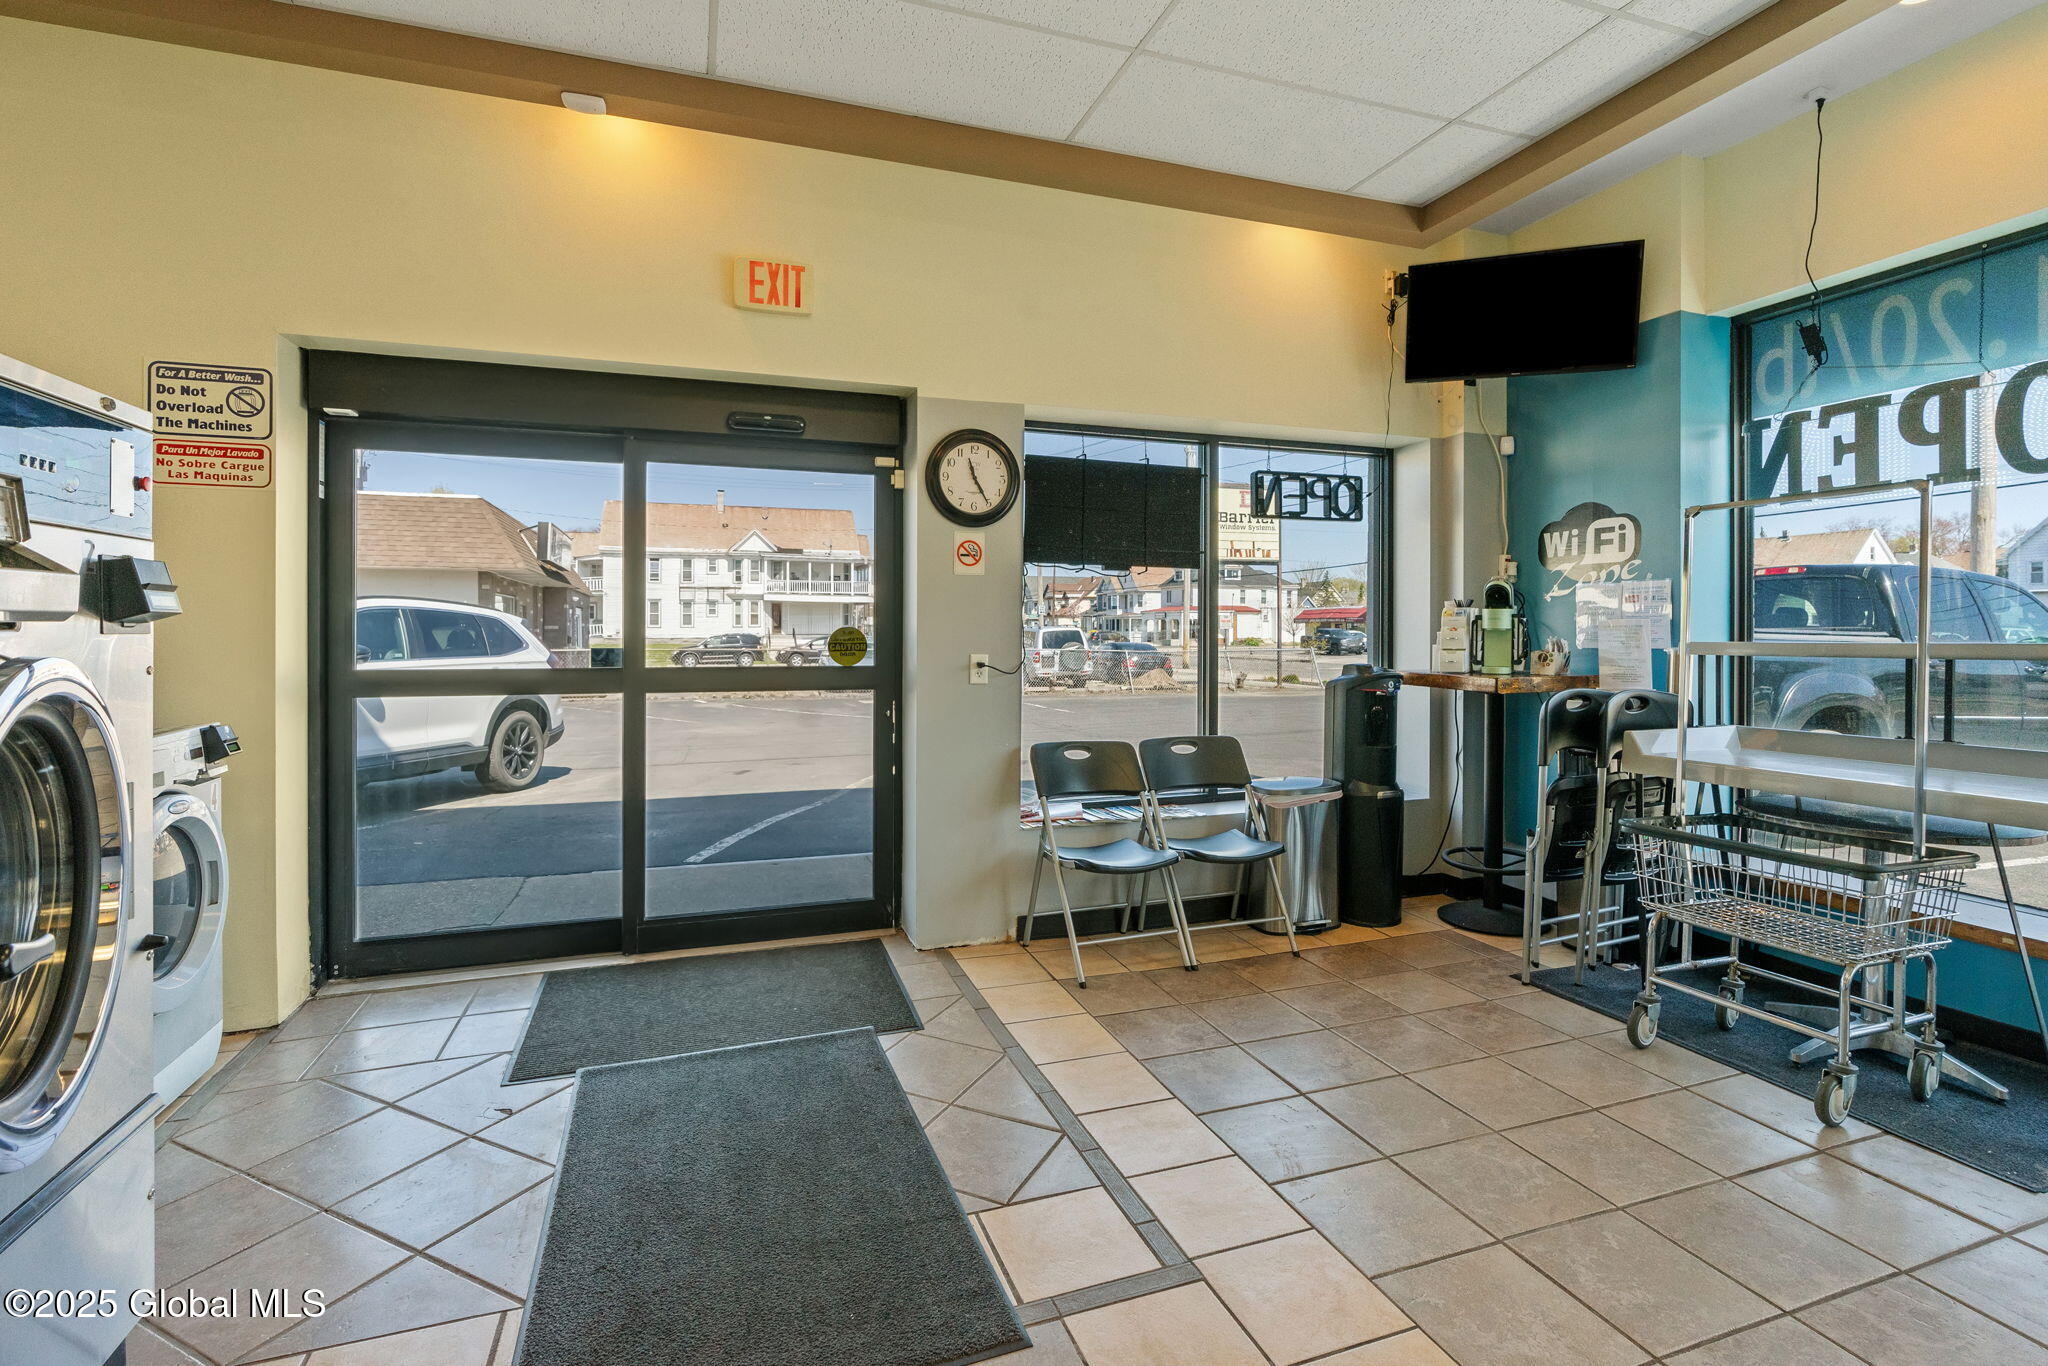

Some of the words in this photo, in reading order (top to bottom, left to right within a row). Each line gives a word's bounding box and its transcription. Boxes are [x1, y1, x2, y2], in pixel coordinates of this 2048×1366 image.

[749, 260, 806, 308] EXIT
[158, 368, 177, 377] For
[178, 370, 186, 378] A
[188, 370, 222, 380] Better
[224, 373, 262, 383] Wash...
[156, 384, 176, 395] Do
[180, 385, 207, 397] Not
[156, 400, 224, 414] Overload
[156, 416, 183, 428] The
[187, 418, 253, 432] Machines
[161, 446, 184, 454] Para
[199, 447, 226, 457] Mejor
[227, 449, 259, 457] Lavado
[957, 448, 963, 457] 11
[970, 445, 980, 455] 12
[156, 458, 173, 467] No
[178, 459, 216, 469] Sobre
[221, 461, 265, 472] Cargue
[947, 458, 956, 467] 10
[167, 469, 189, 479] Las
[193, 471, 254, 482] Maquinas
[942, 471, 949, 481] 9
[958, 497, 964, 507] 7
[970, 502, 977, 511] 6
[1544, 559, 1643, 602] Zone
[830, 643, 866, 651] CAUTION
